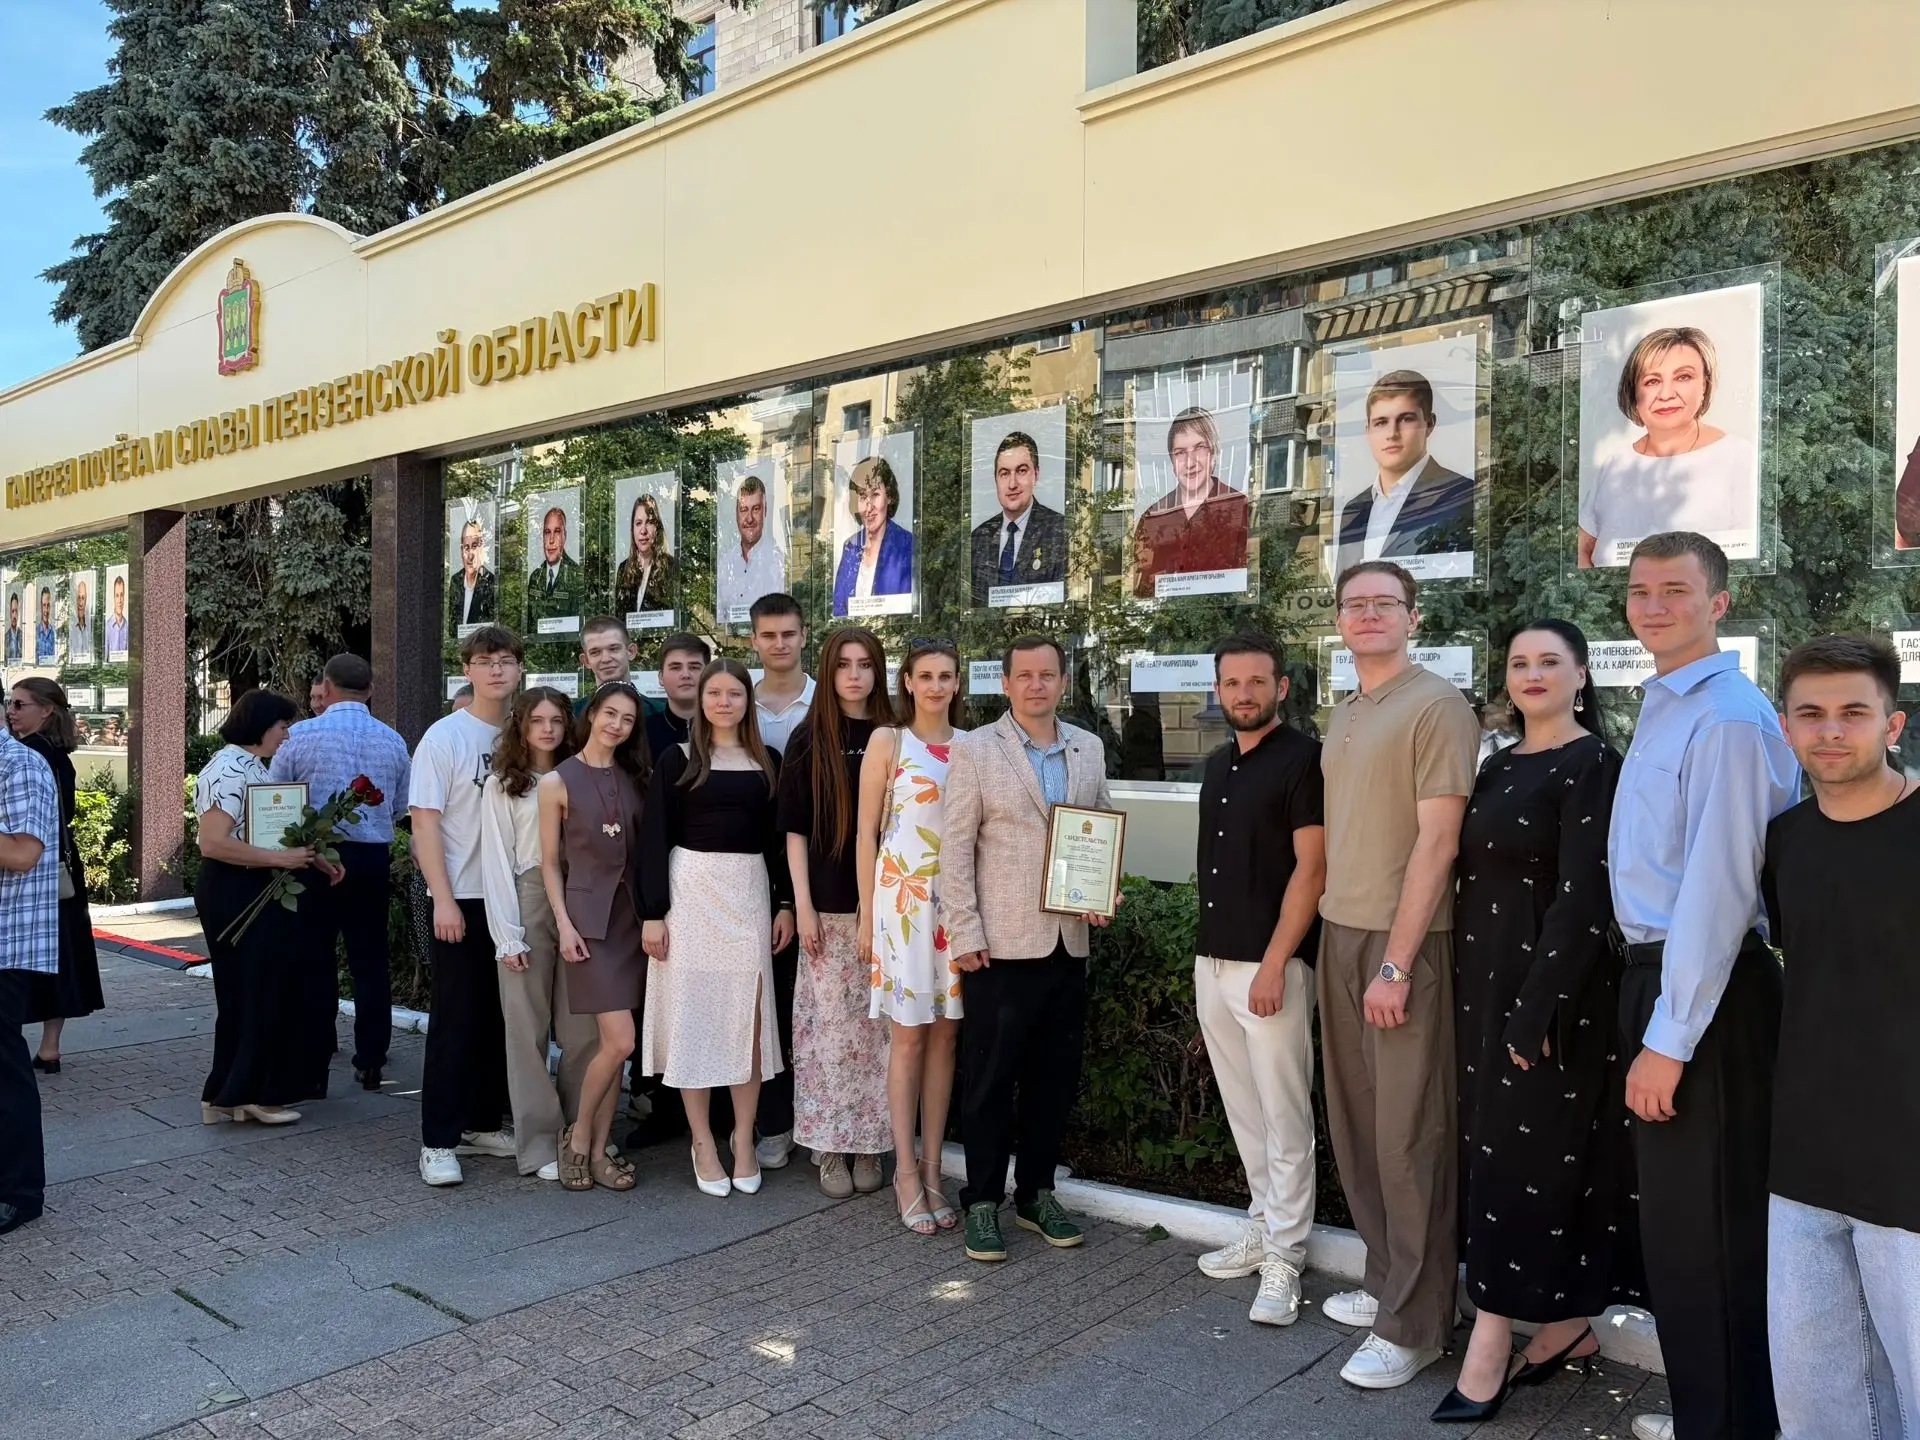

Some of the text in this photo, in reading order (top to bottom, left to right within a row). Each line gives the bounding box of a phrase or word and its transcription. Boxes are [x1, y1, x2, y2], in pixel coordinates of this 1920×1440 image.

[5, 283, 656, 509] ГАЛЕРЕЯ ПОЧЁТА И СЛАВЫ ПЕНЗЕНСКОЙ ОБЛАСТИ
[1901, 638, 1920, 649] ГАС
[1587, 646, 1601, 657] БУЗ
[1612, 659, 1657, 670] КАРАГИЗОВ
